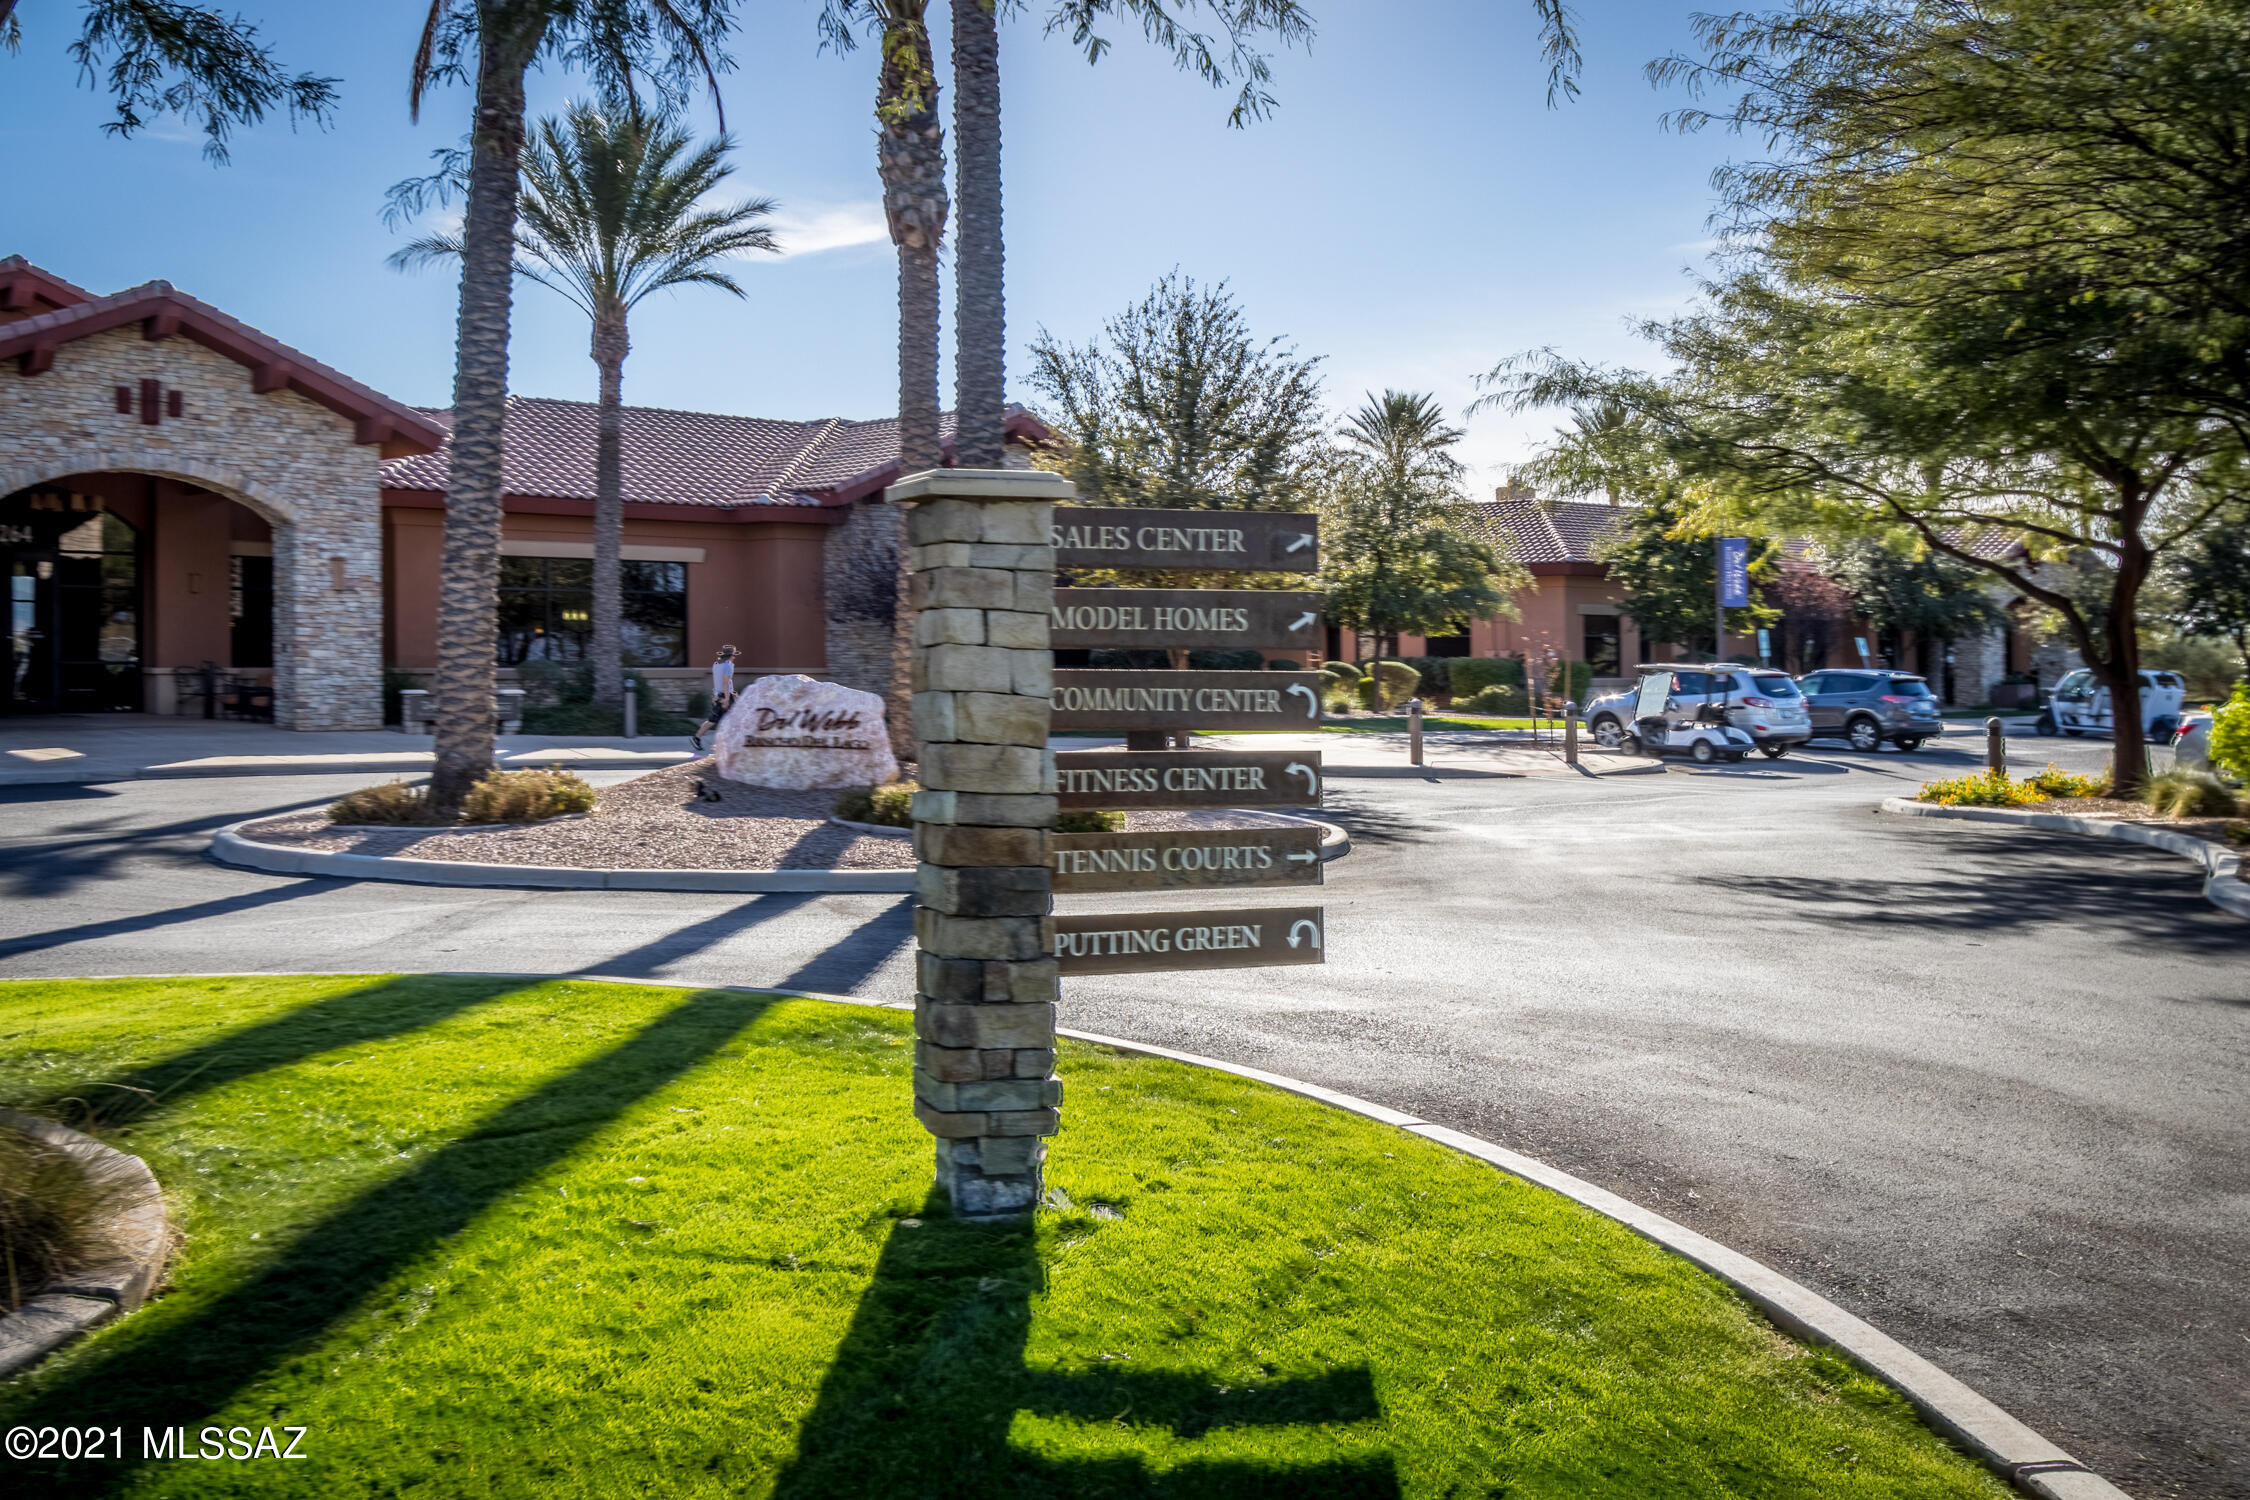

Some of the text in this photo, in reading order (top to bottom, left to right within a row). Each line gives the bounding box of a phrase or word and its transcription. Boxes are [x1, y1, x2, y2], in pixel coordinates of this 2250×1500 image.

[1051, 525, 1248, 552] SALES CENTER
[1052, 606, 1249, 632] MODEL HOMES
[1050, 688, 1283, 713] COMMUNITY CENTER
[756, 707, 862, 733] Del Webb
[1163, 766, 1267, 791] CENTER
[1054, 846, 1273, 874] TENNIS COURTS
[1053, 925, 1263, 957] PUTTING GREEN
